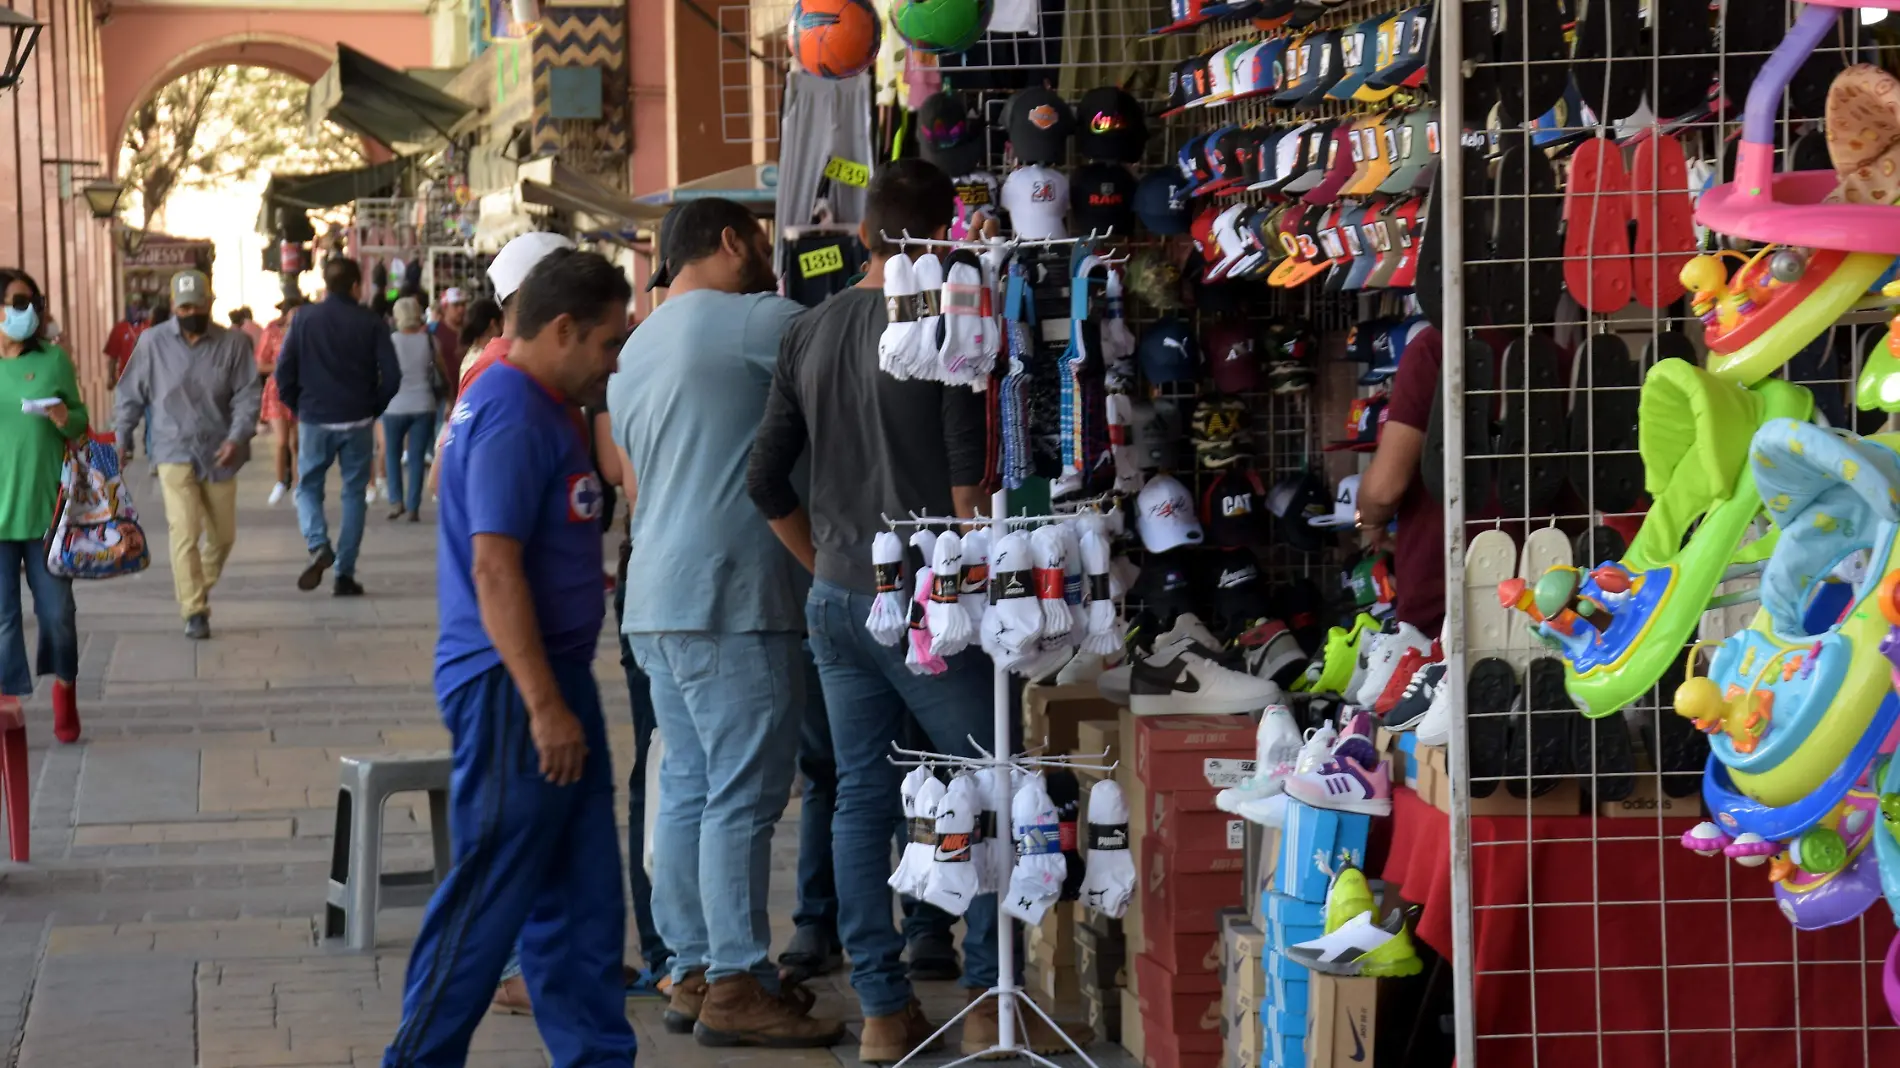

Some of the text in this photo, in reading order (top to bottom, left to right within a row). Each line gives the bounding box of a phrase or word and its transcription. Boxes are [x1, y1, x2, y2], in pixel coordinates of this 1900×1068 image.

[802, 250, 838, 272] 139
[1222, 493, 1252, 517] CAT
[941, 834, 969, 851] NIKE
[1097, 836, 1123, 846] PUMA
